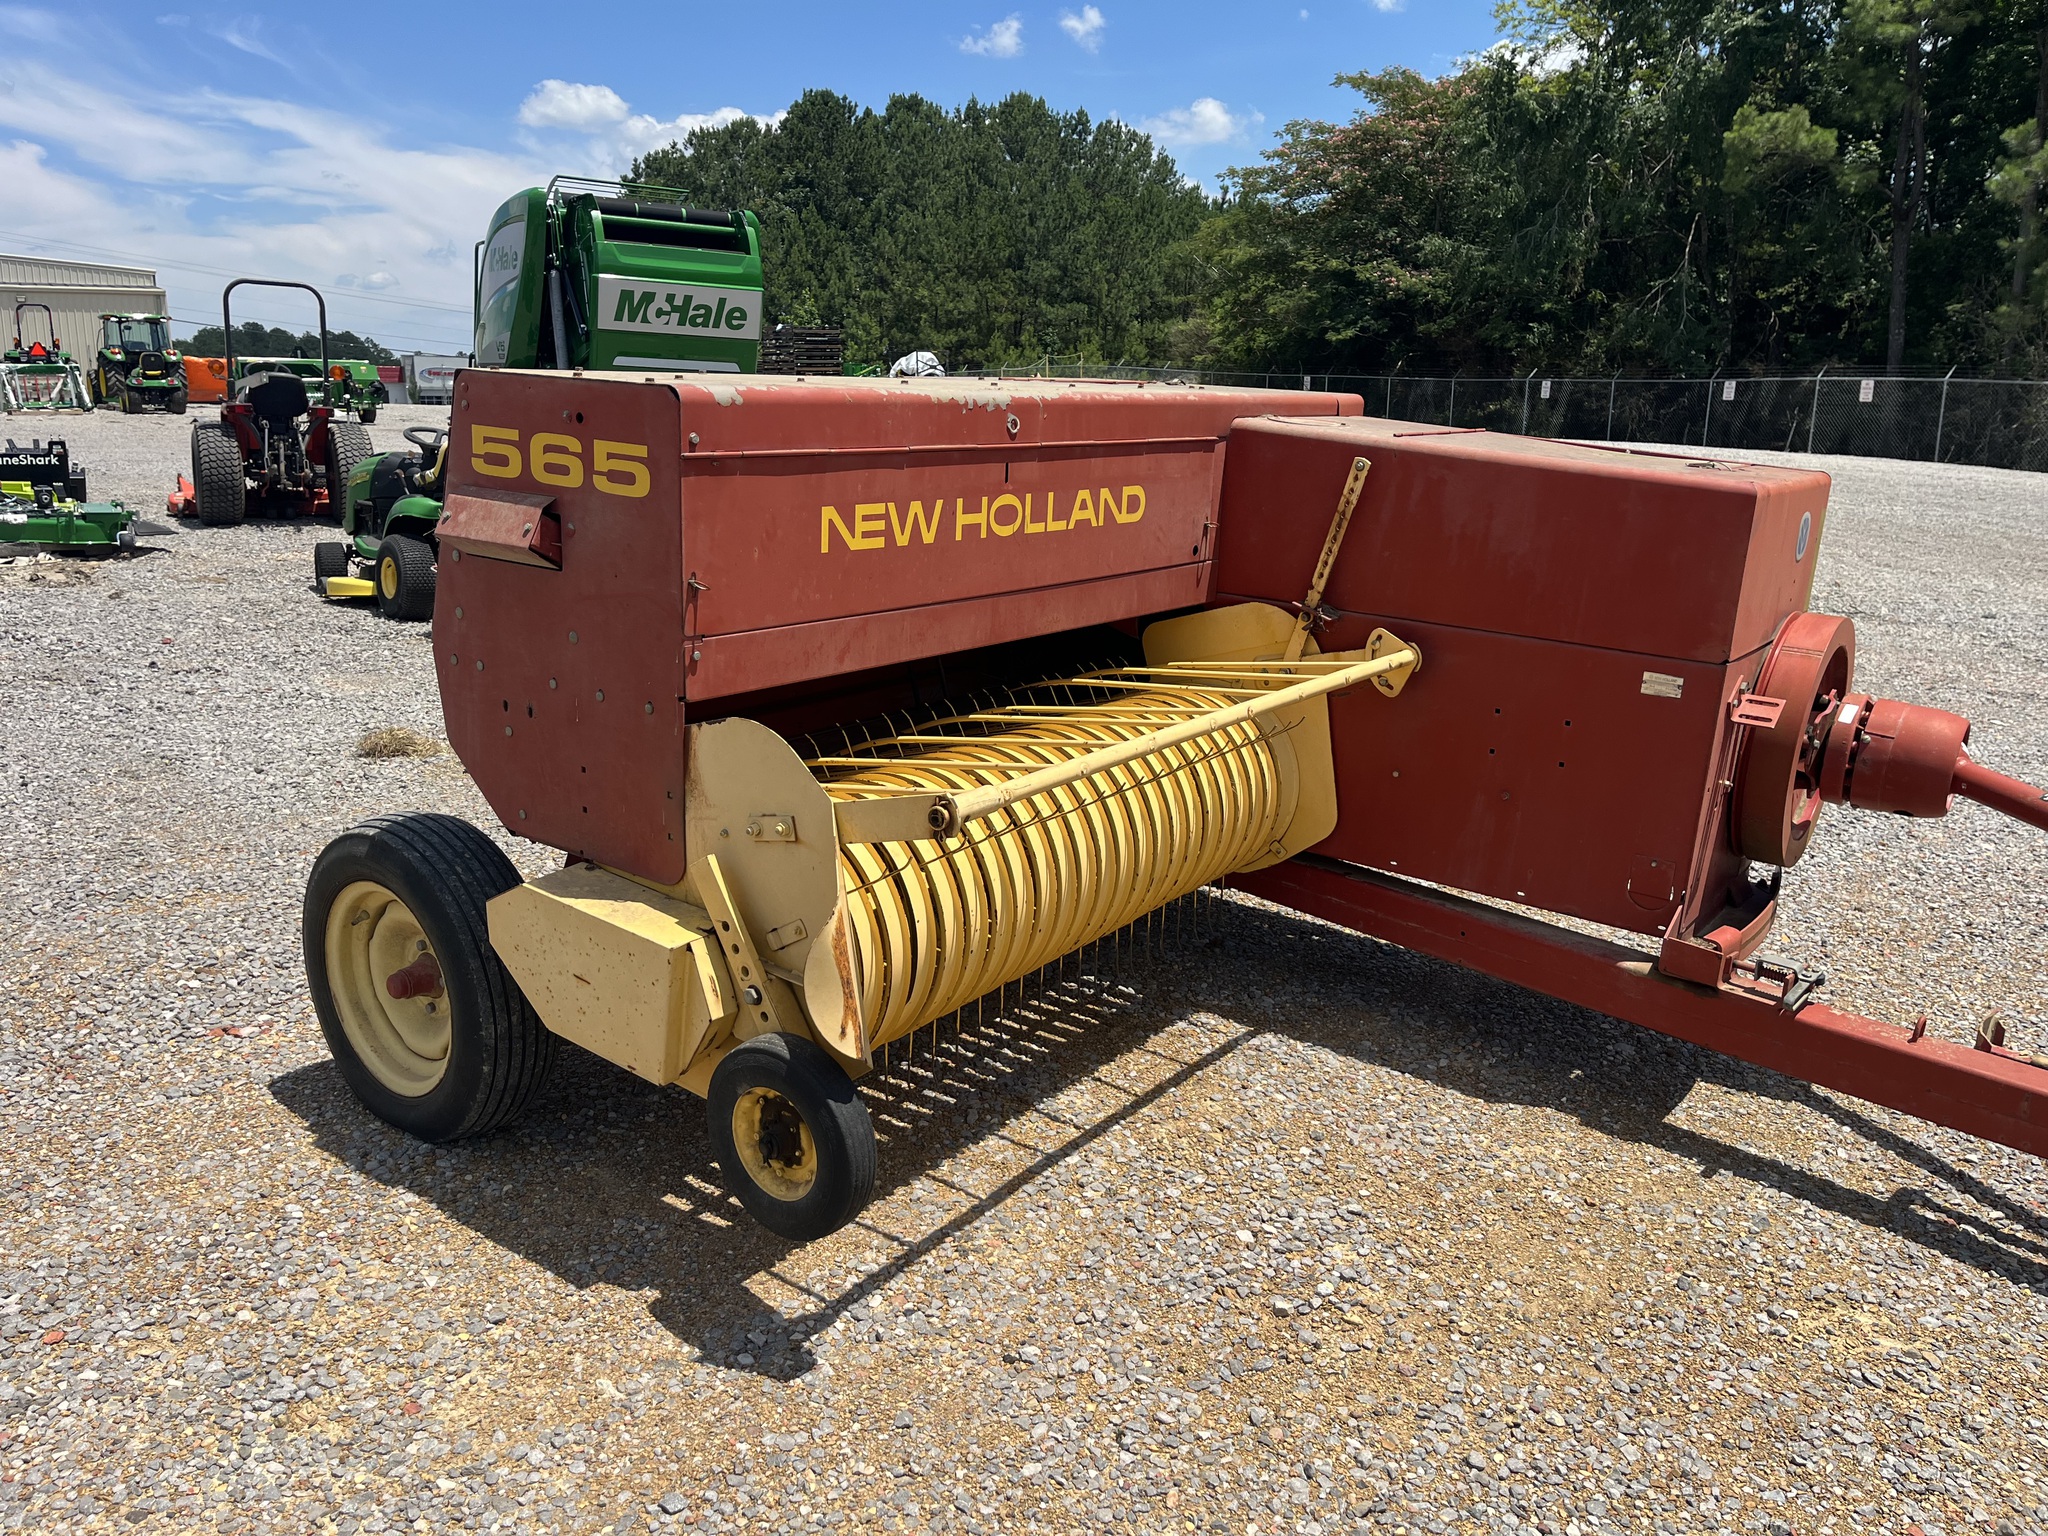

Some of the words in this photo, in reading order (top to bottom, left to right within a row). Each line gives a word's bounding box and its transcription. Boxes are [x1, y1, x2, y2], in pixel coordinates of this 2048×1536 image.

[489, 245, 518, 272] McHale
[614, 289, 748, 331] McHale
[0, 454, 60, 465] neShark
[471, 424, 651, 498] 565
[821, 499, 943, 554] NEW
[955, 485, 1146, 541] HOLLAND
